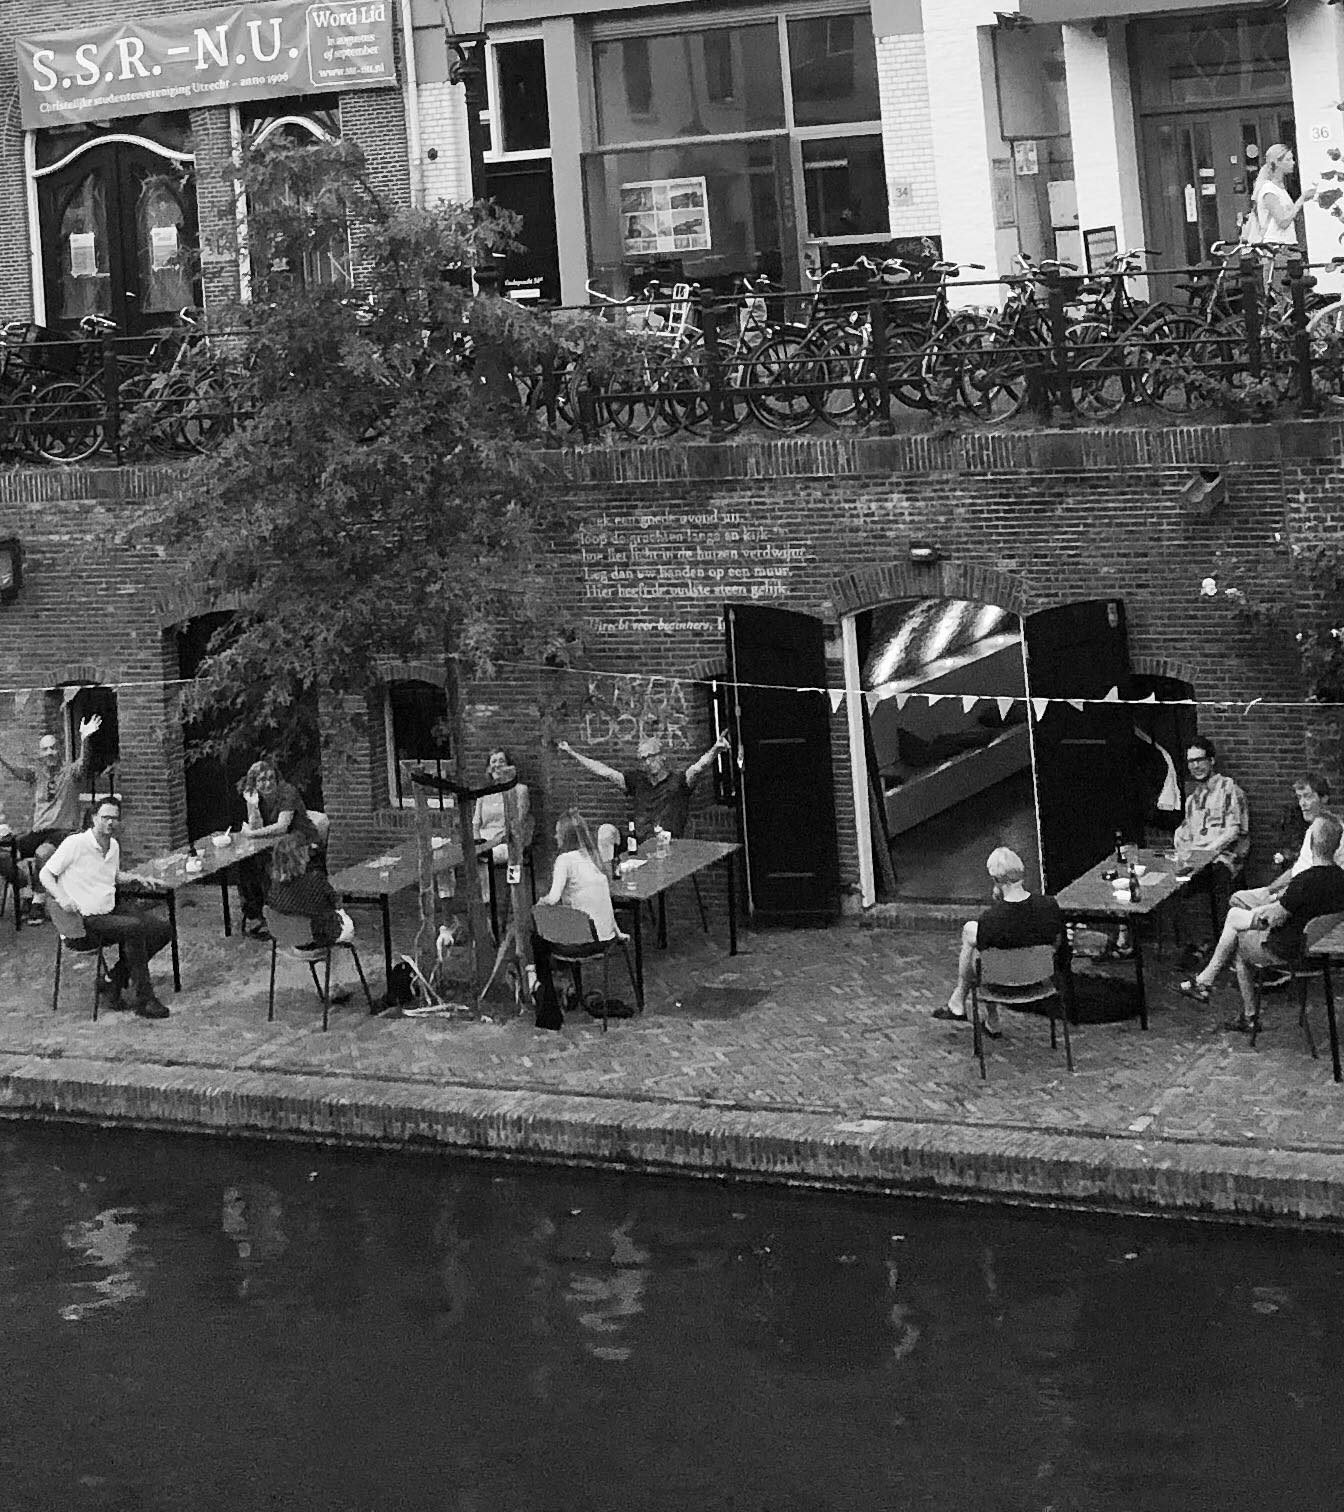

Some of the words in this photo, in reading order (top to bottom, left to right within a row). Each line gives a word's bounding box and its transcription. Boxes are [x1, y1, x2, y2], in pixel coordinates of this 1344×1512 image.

[312, 6, 357, 28] Word
[359, 3, 386, 24] Lid
[191, 79, 231, 93] Utrecht
[1312, 126, 1330, 140] 36
[896, 187, 908, 198] 34
[697, 545, 739, 561] huizen
[610, 565, 634, 580] dan
[708, 568, 725, 580] op
[728, 568, 751, 578] een
[585, 584, 613, 598] Hier
